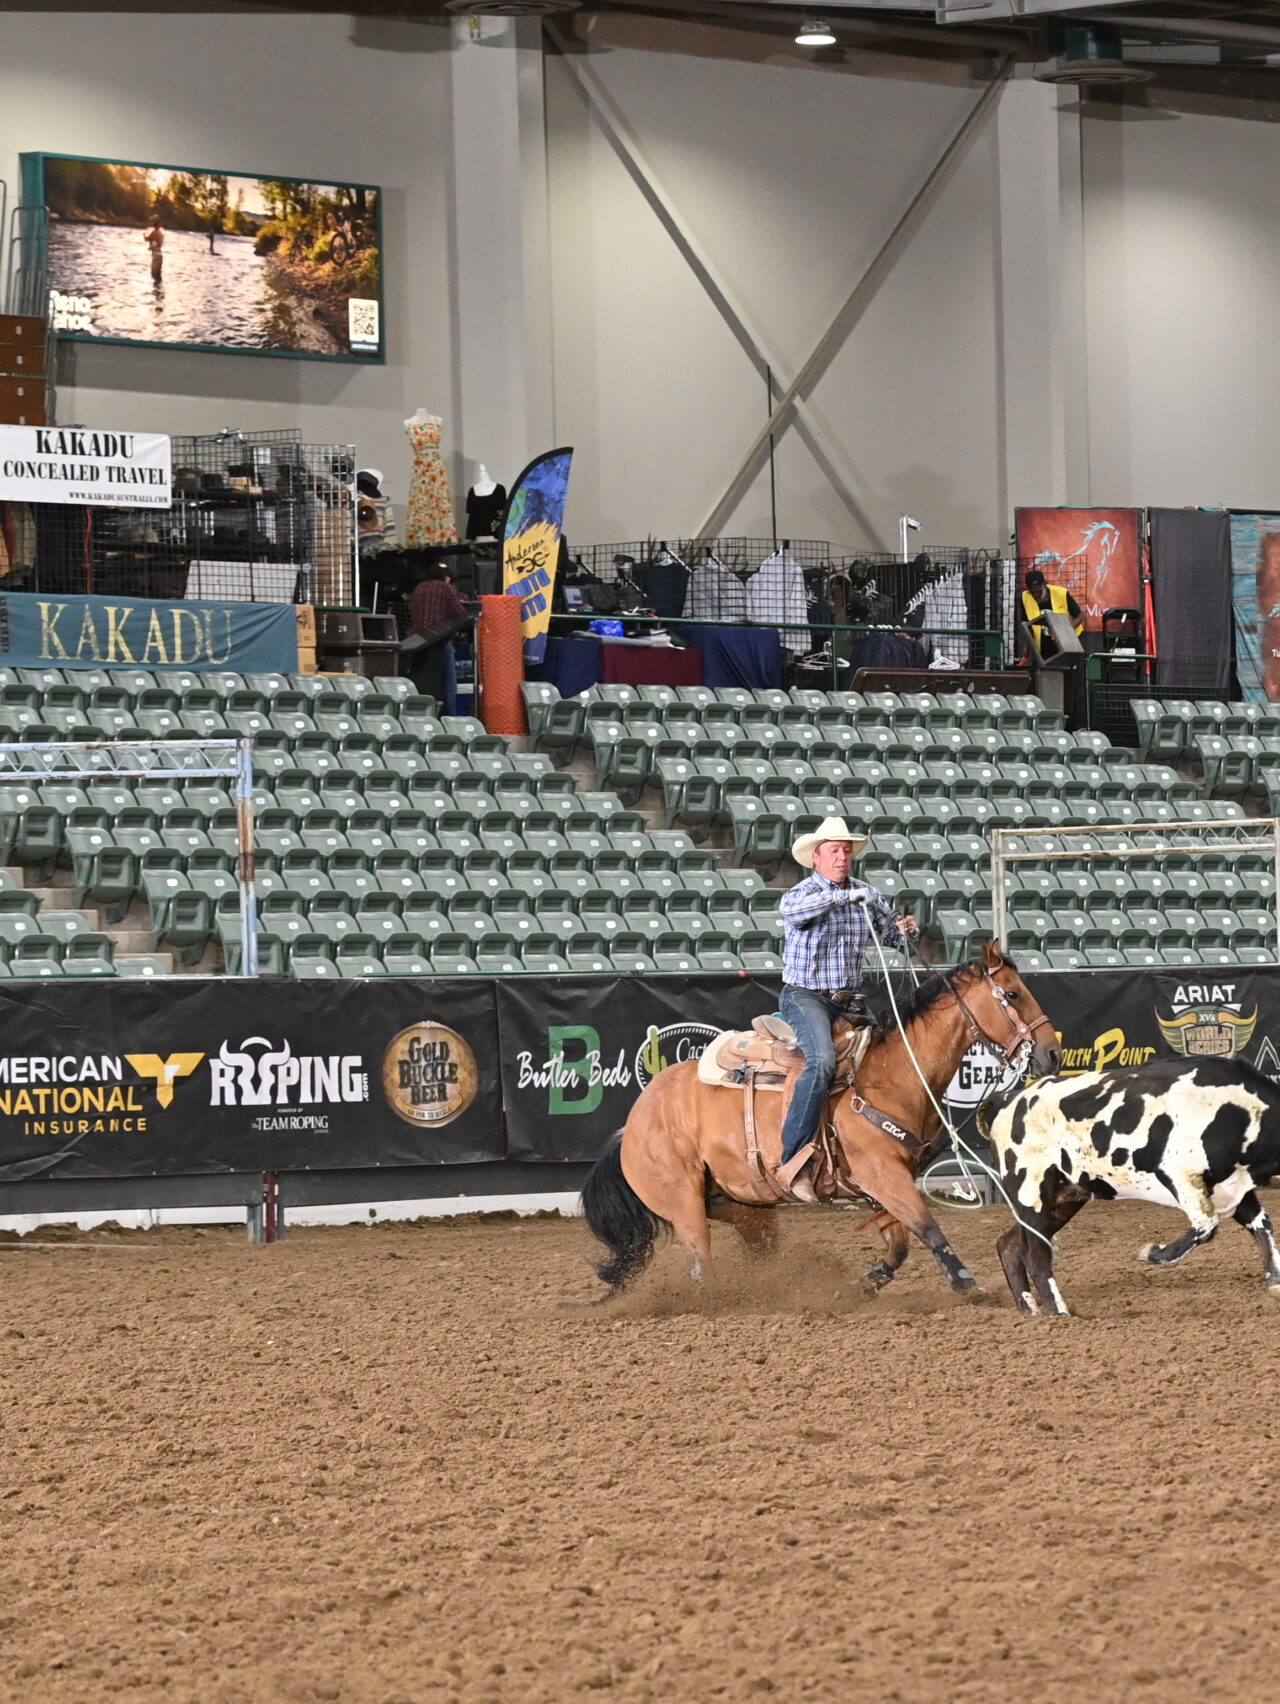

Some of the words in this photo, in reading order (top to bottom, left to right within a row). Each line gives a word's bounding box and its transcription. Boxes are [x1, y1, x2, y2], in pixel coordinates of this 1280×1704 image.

[49, 290, 91, 313] Reno
[36, 429, 134, 459] KAKADU
[3, 460, 100, 482] CONCEALED
[105, 465, 168, 485] TRAVEL
[505, 539, 544, 571] Andersen
[37, 602, 234, 665] KAKADU
[1174, 984, 1236, 1003] ARIAT
[1184, 1026, 1232, 1041] WORLD
[408, 1036, 450, 1064] GOLD
[676, 1038, 708, 1064] Cact
[1094, 1028, 1156, 1072] POINT
[398, 1060, 458, 1089] BUCKLE
[517, 1050, 580, 1089] Butler
[586, 1049, 631, 1088] Beds
[548, 1025, 603, 1115] B
[959, 1061, 1005, 1090] GEAR
[0, 1086, 143, 1116] NATIONAL
[411, 1083, 448, 1106] BEER
[25, 1118, 147, 1135] INSURANCE
[256, 1116, 288, 1130] TEAM
[290, 1115, 328, 1130] ROPING
